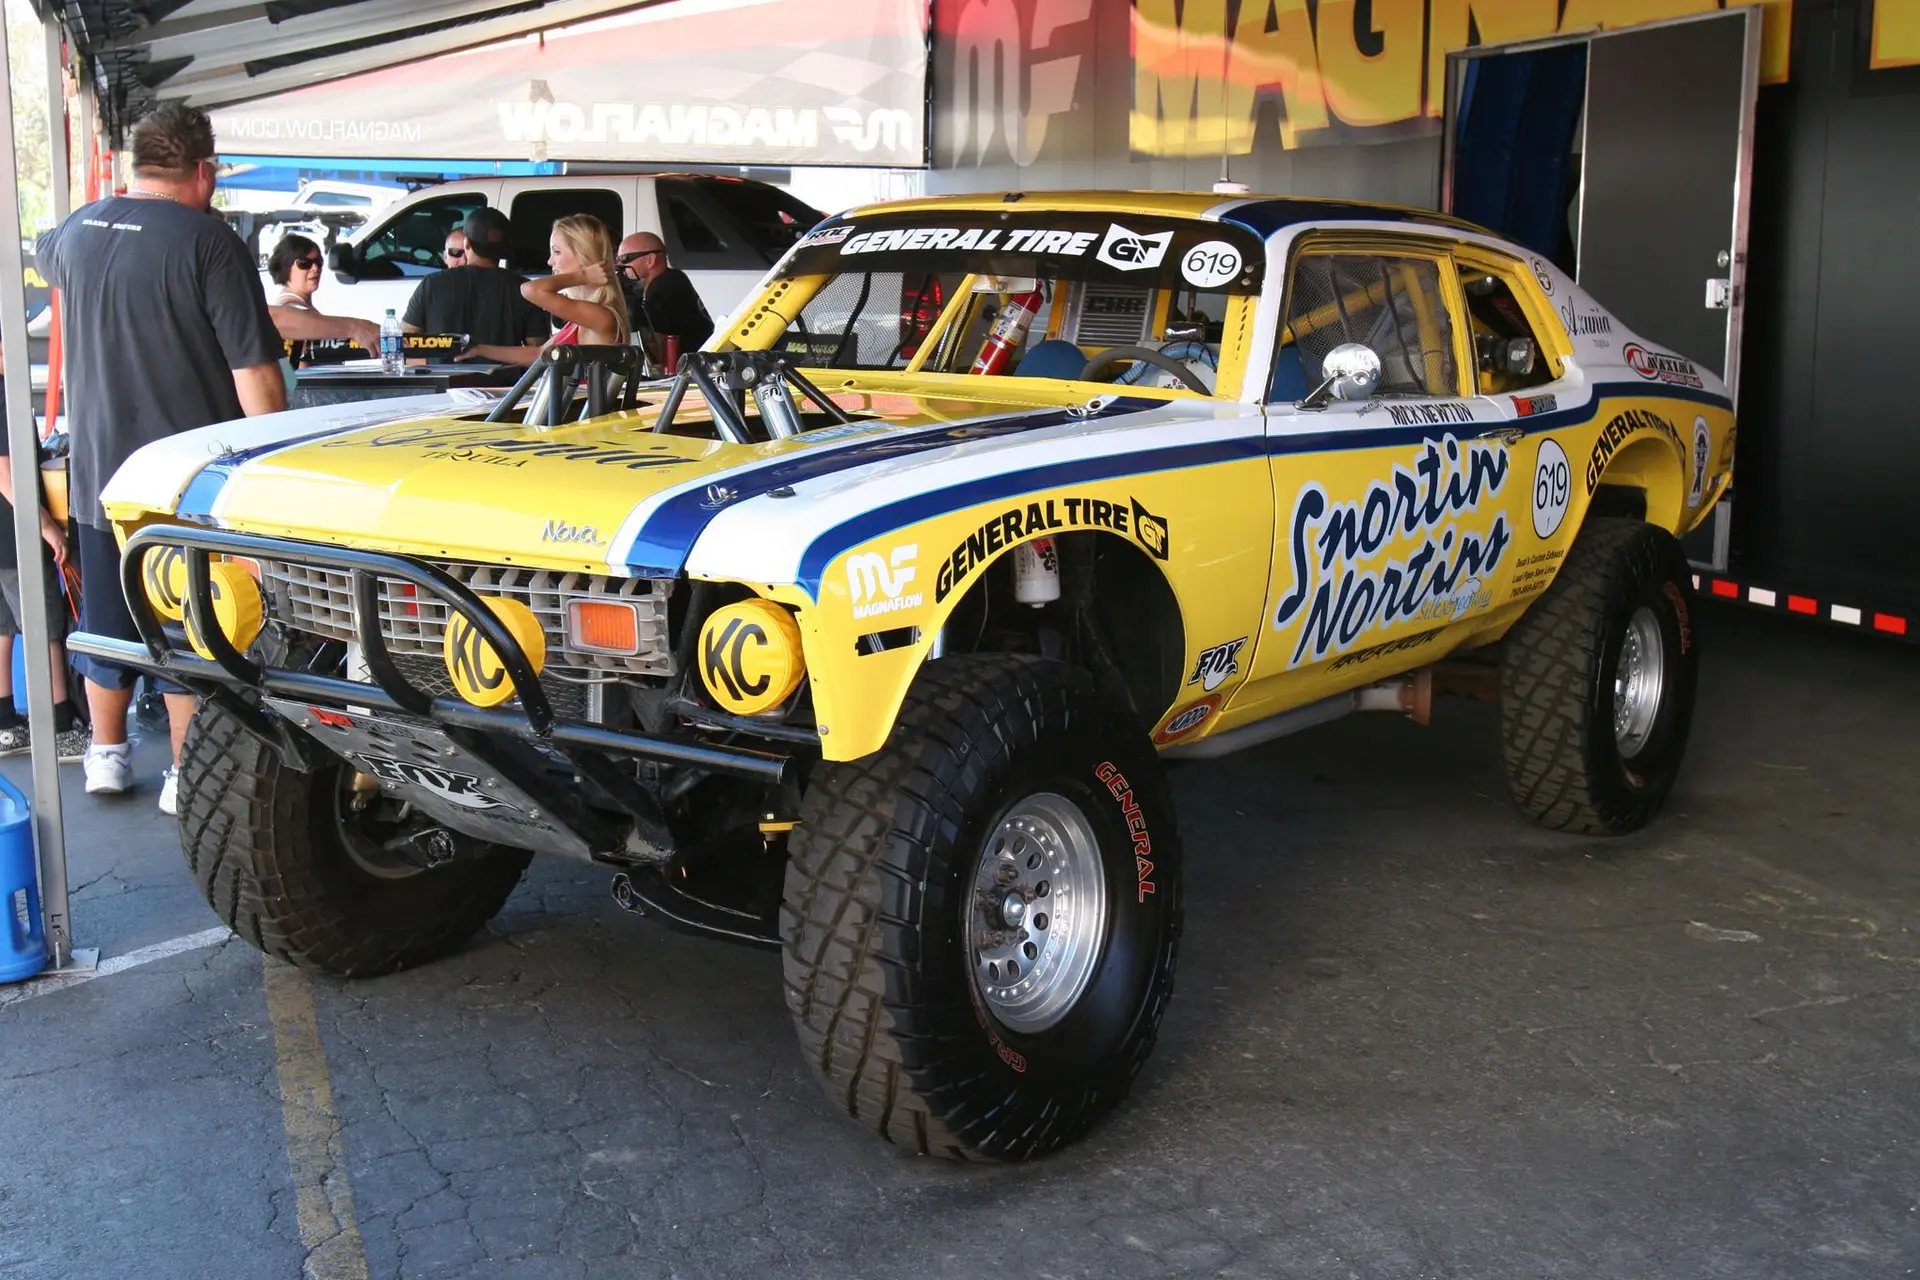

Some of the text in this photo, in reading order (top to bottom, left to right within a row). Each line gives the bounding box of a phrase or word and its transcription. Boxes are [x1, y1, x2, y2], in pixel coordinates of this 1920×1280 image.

[840, 228, 1002, 256] GENERAL
[1001, 229, 1100, 256] TIRE
[1186, 249, 1237, 276] 619
[1384, 405, 1421, 425] MICK
[1419, 402, 1475, 424] NEWTON
[421, 450, 529, 468] TEQUILA
[1586, 409, 1647, 497] GENERAL
[1536, 461, 1568, 510] 619
[541, 518, 606, 546] Nova
[936, 499, 1063, 605] GENERAL
[1063, 498, 1130, 534] TIRE
[852, 593, 923, 620] MAGNAFLOW
[451, 617, 506, 694] KC
[705, 617, 772, 702] KC
[1187, 636, 1248, 690] FOX
[355, 752, 524, 810] FOX
[1096, 760, 1156, 904] GENERAL
